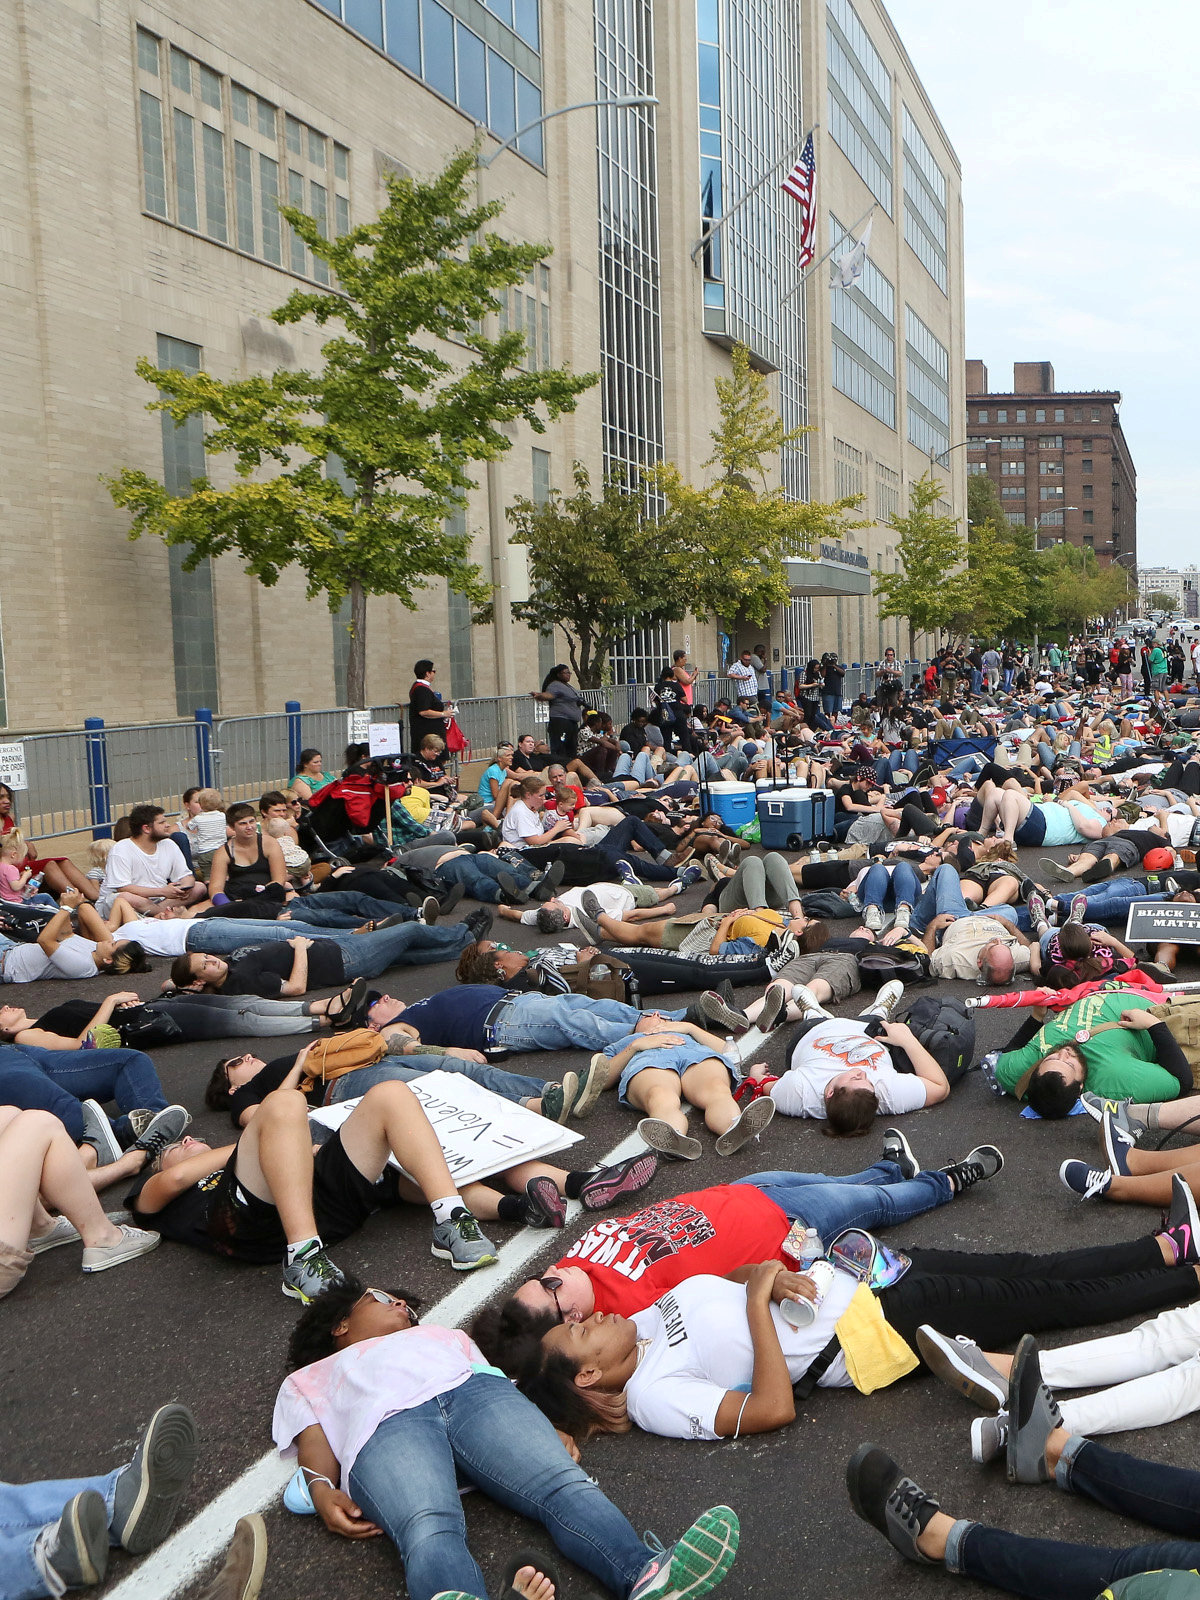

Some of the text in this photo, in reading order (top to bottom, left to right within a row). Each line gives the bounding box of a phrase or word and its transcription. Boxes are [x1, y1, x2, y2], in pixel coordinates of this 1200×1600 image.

[1136, 909, 1184, 918] BLACK
[588, 1217, 680, 1266] MOR
[612, 1246, 652, 1282] IT
[665, 1312, 688, 1348] LIVE
